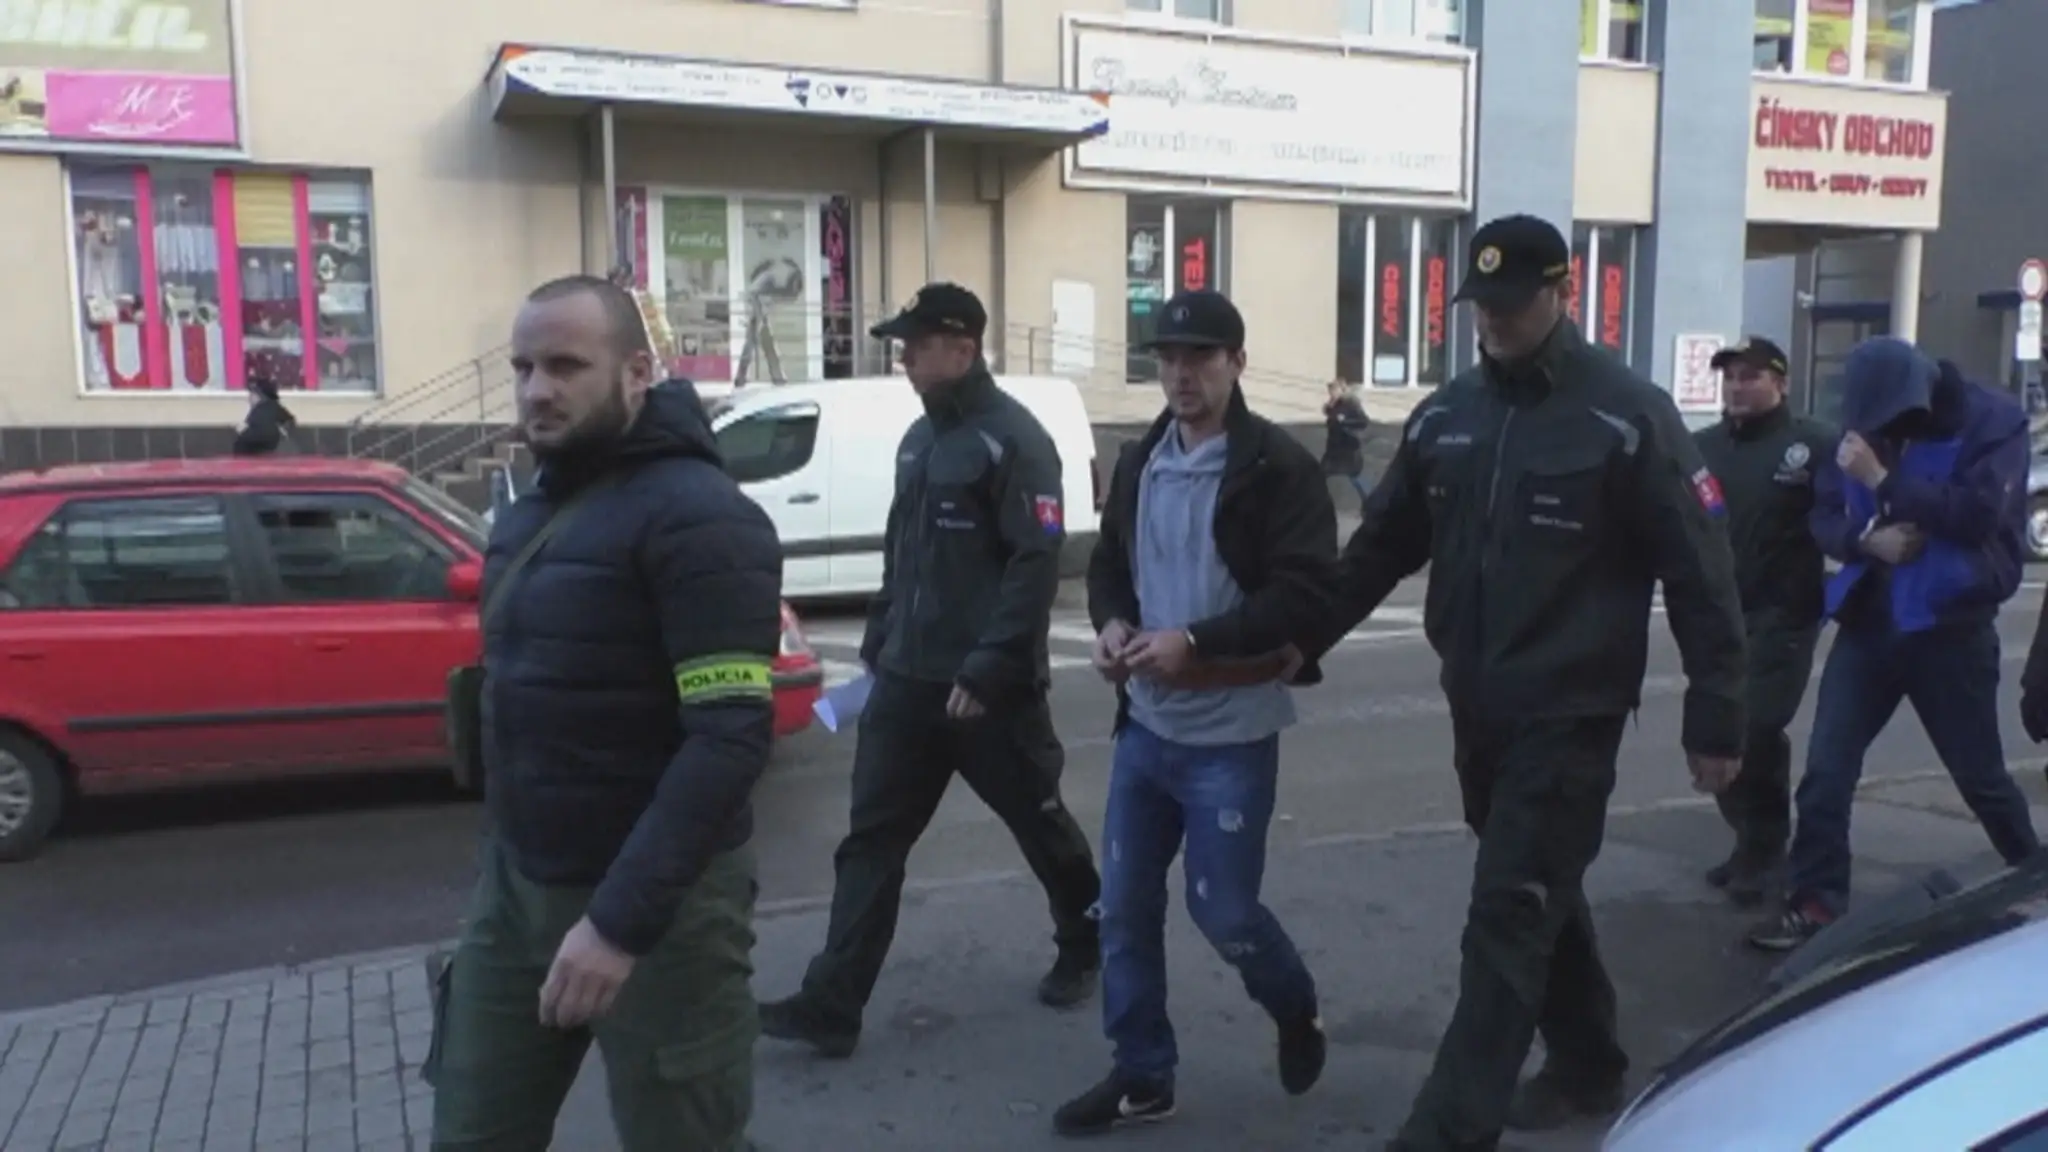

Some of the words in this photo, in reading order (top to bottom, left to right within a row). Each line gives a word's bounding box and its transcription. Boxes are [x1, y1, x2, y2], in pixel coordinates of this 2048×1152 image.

[1755, 96, 1838, 152] ČÍNSKY
[1843, 114, 1934, 160] OBCHOD
[1184, 237, 1206, 292] TE
